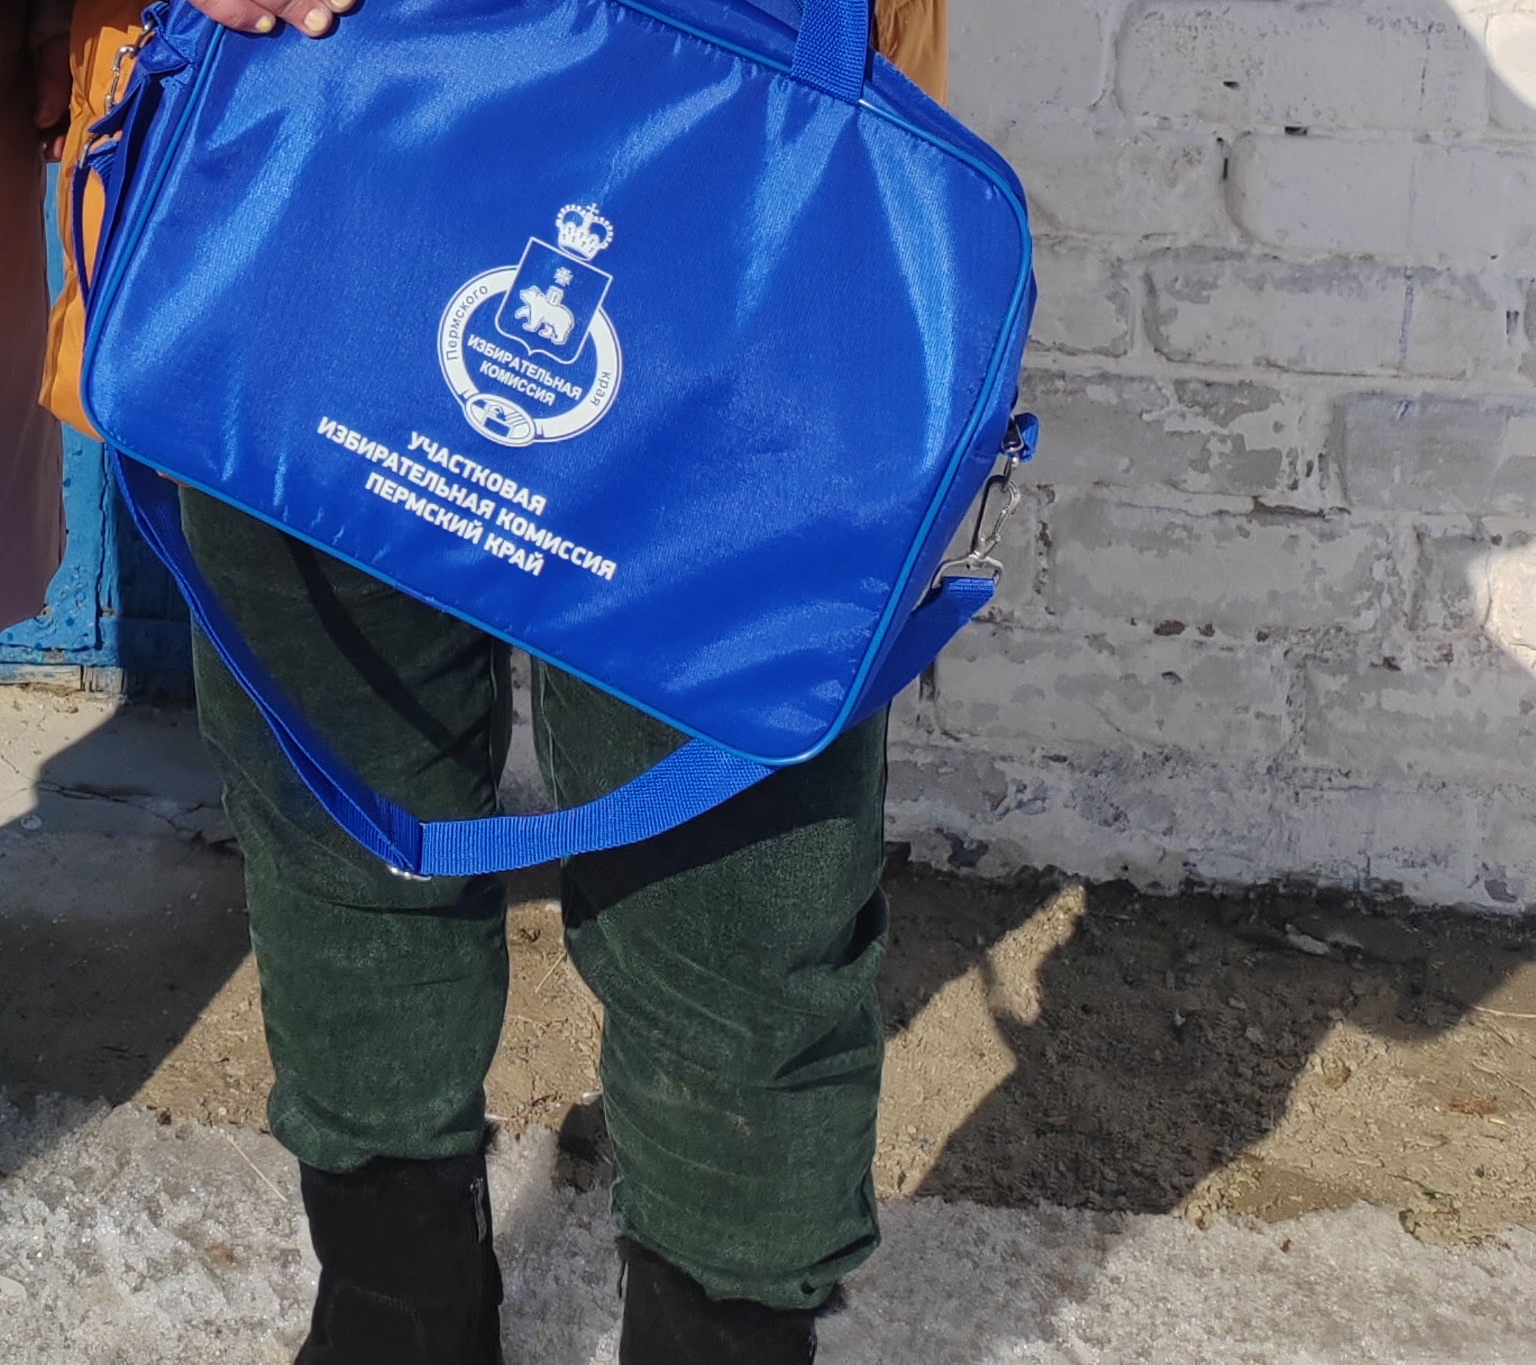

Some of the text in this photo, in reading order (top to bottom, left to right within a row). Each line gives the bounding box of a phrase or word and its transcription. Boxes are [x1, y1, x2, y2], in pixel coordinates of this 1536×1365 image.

[445, 284, 489, 361] Пермского
[467, 333, 583, 401] ИЗБИРАТЕЛЬНАЯ
[479, 359, 556, 407] КОМИССИЯ
[589, 370, 612, 407] края
[316, 415, 618, 581] ИЗБИРАТЕЛЬНАЯ КОМИССИЯ
[407, 430, 548, 516] УЧАСТКОВАЯ
[364, 470, 546, 577] ПЕРМСКИЙ КРАЙ
